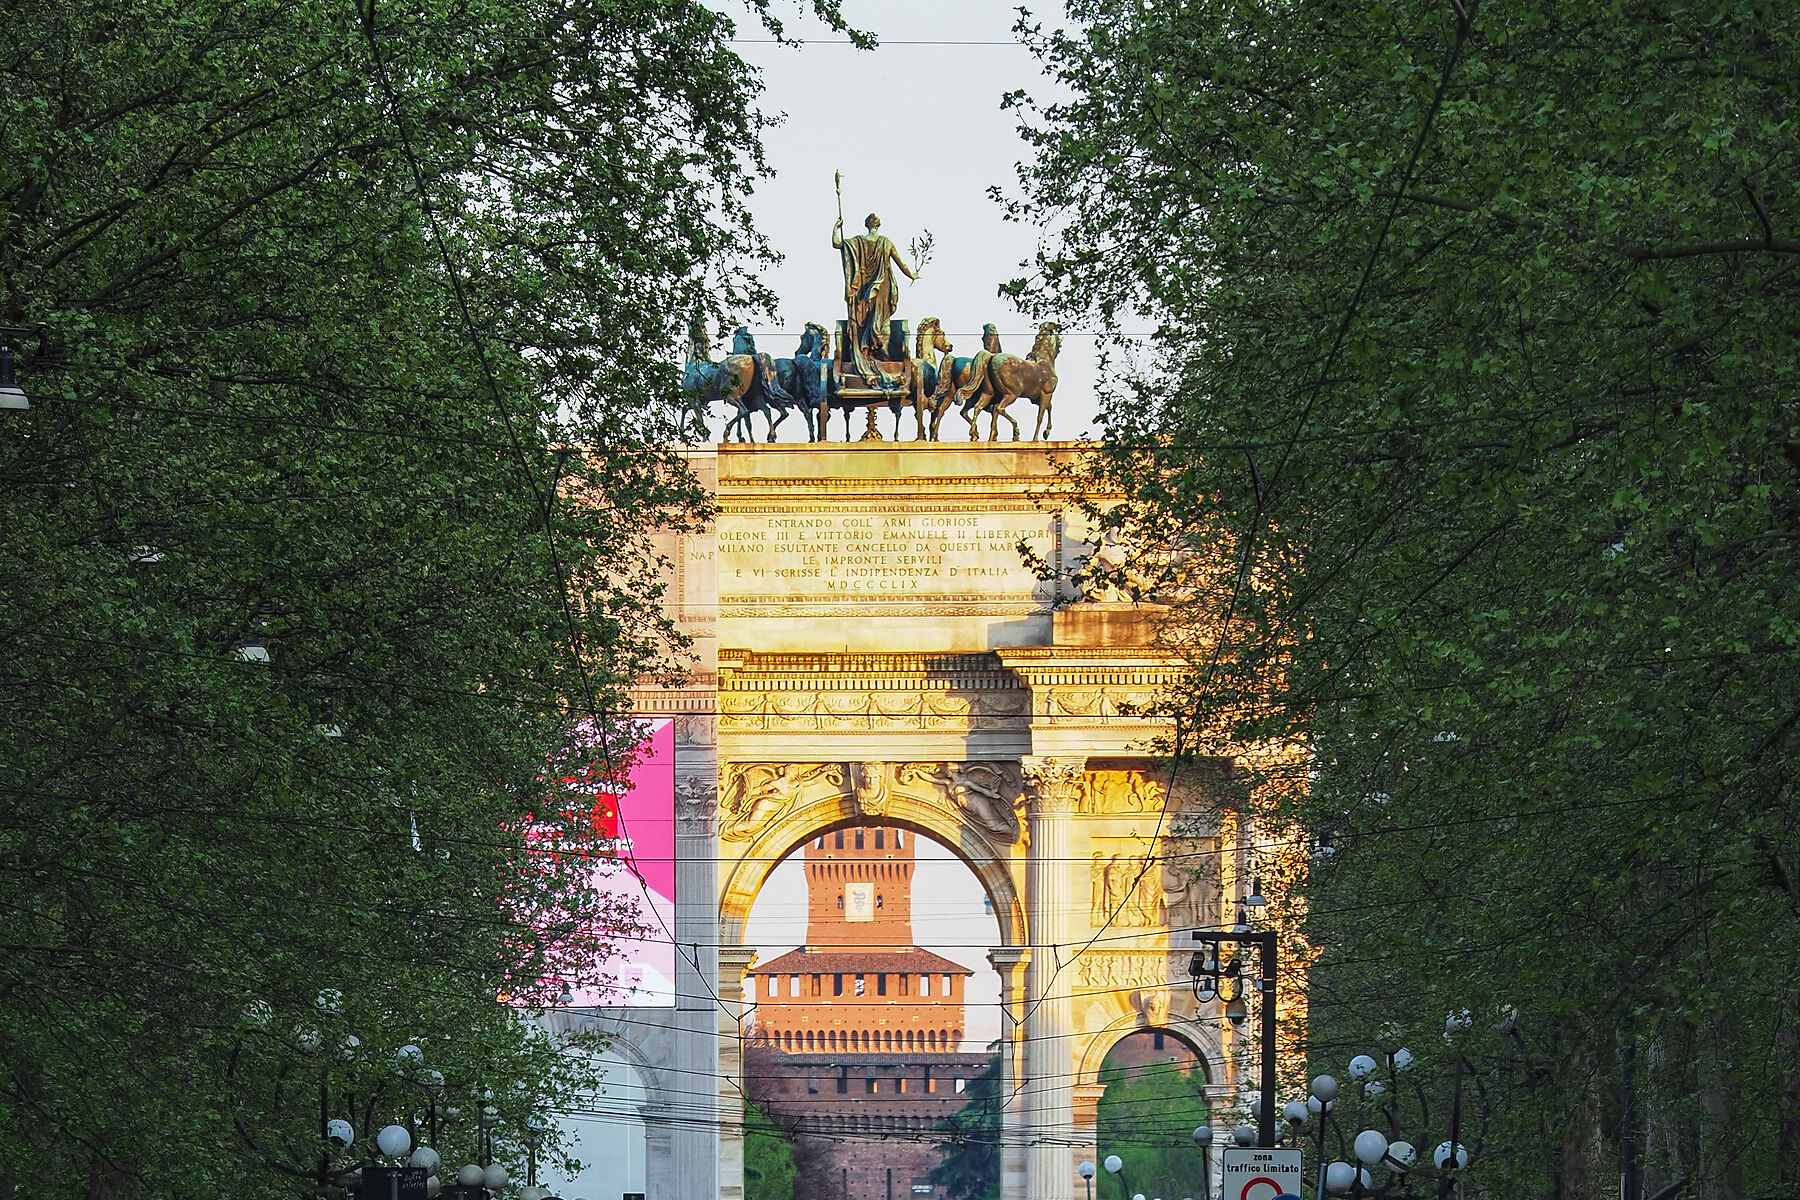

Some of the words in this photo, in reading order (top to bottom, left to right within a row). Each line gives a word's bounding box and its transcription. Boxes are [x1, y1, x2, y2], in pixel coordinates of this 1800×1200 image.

[768, 518, 832, 528] ENTRANDO
[882, 518, 911, 527] ARMI
[921, 517, 979, 527] GLORIOSE
[720, 531, 766, 541] OLEONE
[776, 531, 789, 540] III
[799, 531, 805, 540] E
[815, 531, 873, 540] VITTORIO
[883, 530, 948, 540] EMANUELE
[957, 530, 966, 539] II
[975, 529, 1049, 539] LIBERATORI
[718, 544, 764, 553] MILANO
[774, 543, 838, 553] ESULTANTE
[916, 543, 929, 552] DA
[939, 542, 981, 552] QUESTI
[690, 551, 715, 560] NAP
[803, 556, 815, 565] LE
[825, 556, 887, 565] IMPRONTE
[896, 555, 942, 565] SERVILI
[736, 569, 741, 577] E
[753, 569, 764, 577] VI
[774, 568, 820, 578] SCRISSE
[846, 567, 938, 577] INDIPENDENZA
[968, 567, 1008, 576] ITALIA
[827, 580, 918, 590] MDCCCLIX
[1226, 1163, 1261, 1173] traffico
[1263, 1163, 1299, 1173] limitato
